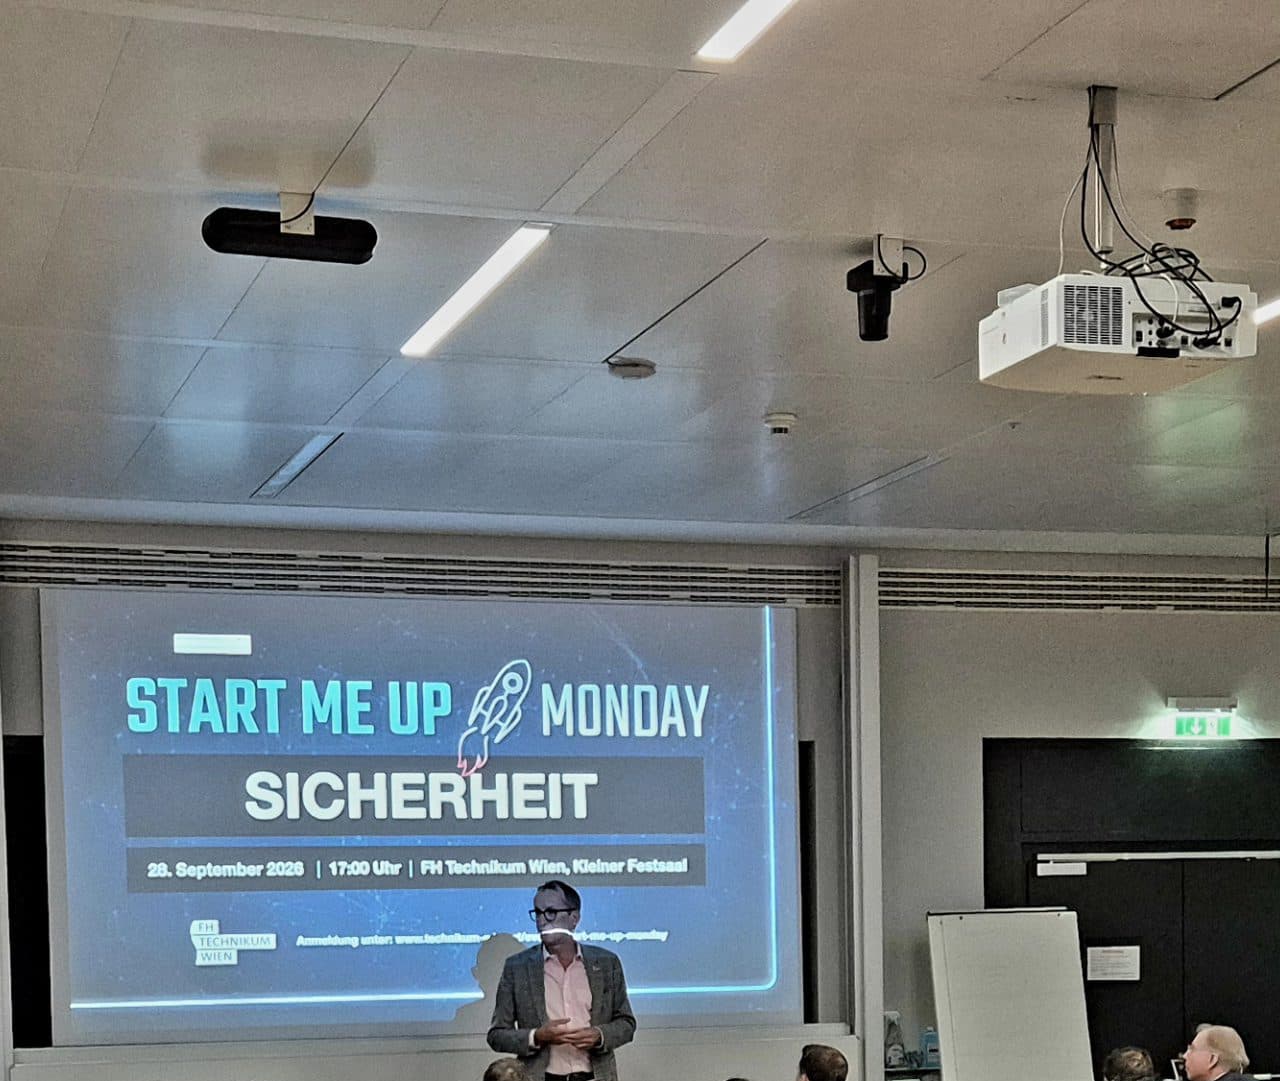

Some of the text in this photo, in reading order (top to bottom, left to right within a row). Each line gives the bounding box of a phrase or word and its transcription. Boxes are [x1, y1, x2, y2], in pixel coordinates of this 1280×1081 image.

[126, 677, 710, 737] START ME UP MONDAY
[245, 771, 598, 820] SICHERHEIT
[175, 861, 264, 880] September
[329, 860, 370, 877] 17:00
[373, 860, 402, 876] Uhr
[420, 860, 442, 876] FH
[445, 859, 526, 876] Technikum
[529, 858, 570, 876] Wien,
[573, 858, 625, 874] Kleiner
[627, 857, 688, 873] Festsaal
[198, 922, 214, 932] FH
[200, 937, 272, 947] TECHNIKUM
[296, 934, 359, 948] Anmeldung
[201, 951, 233, 961] WIEN
